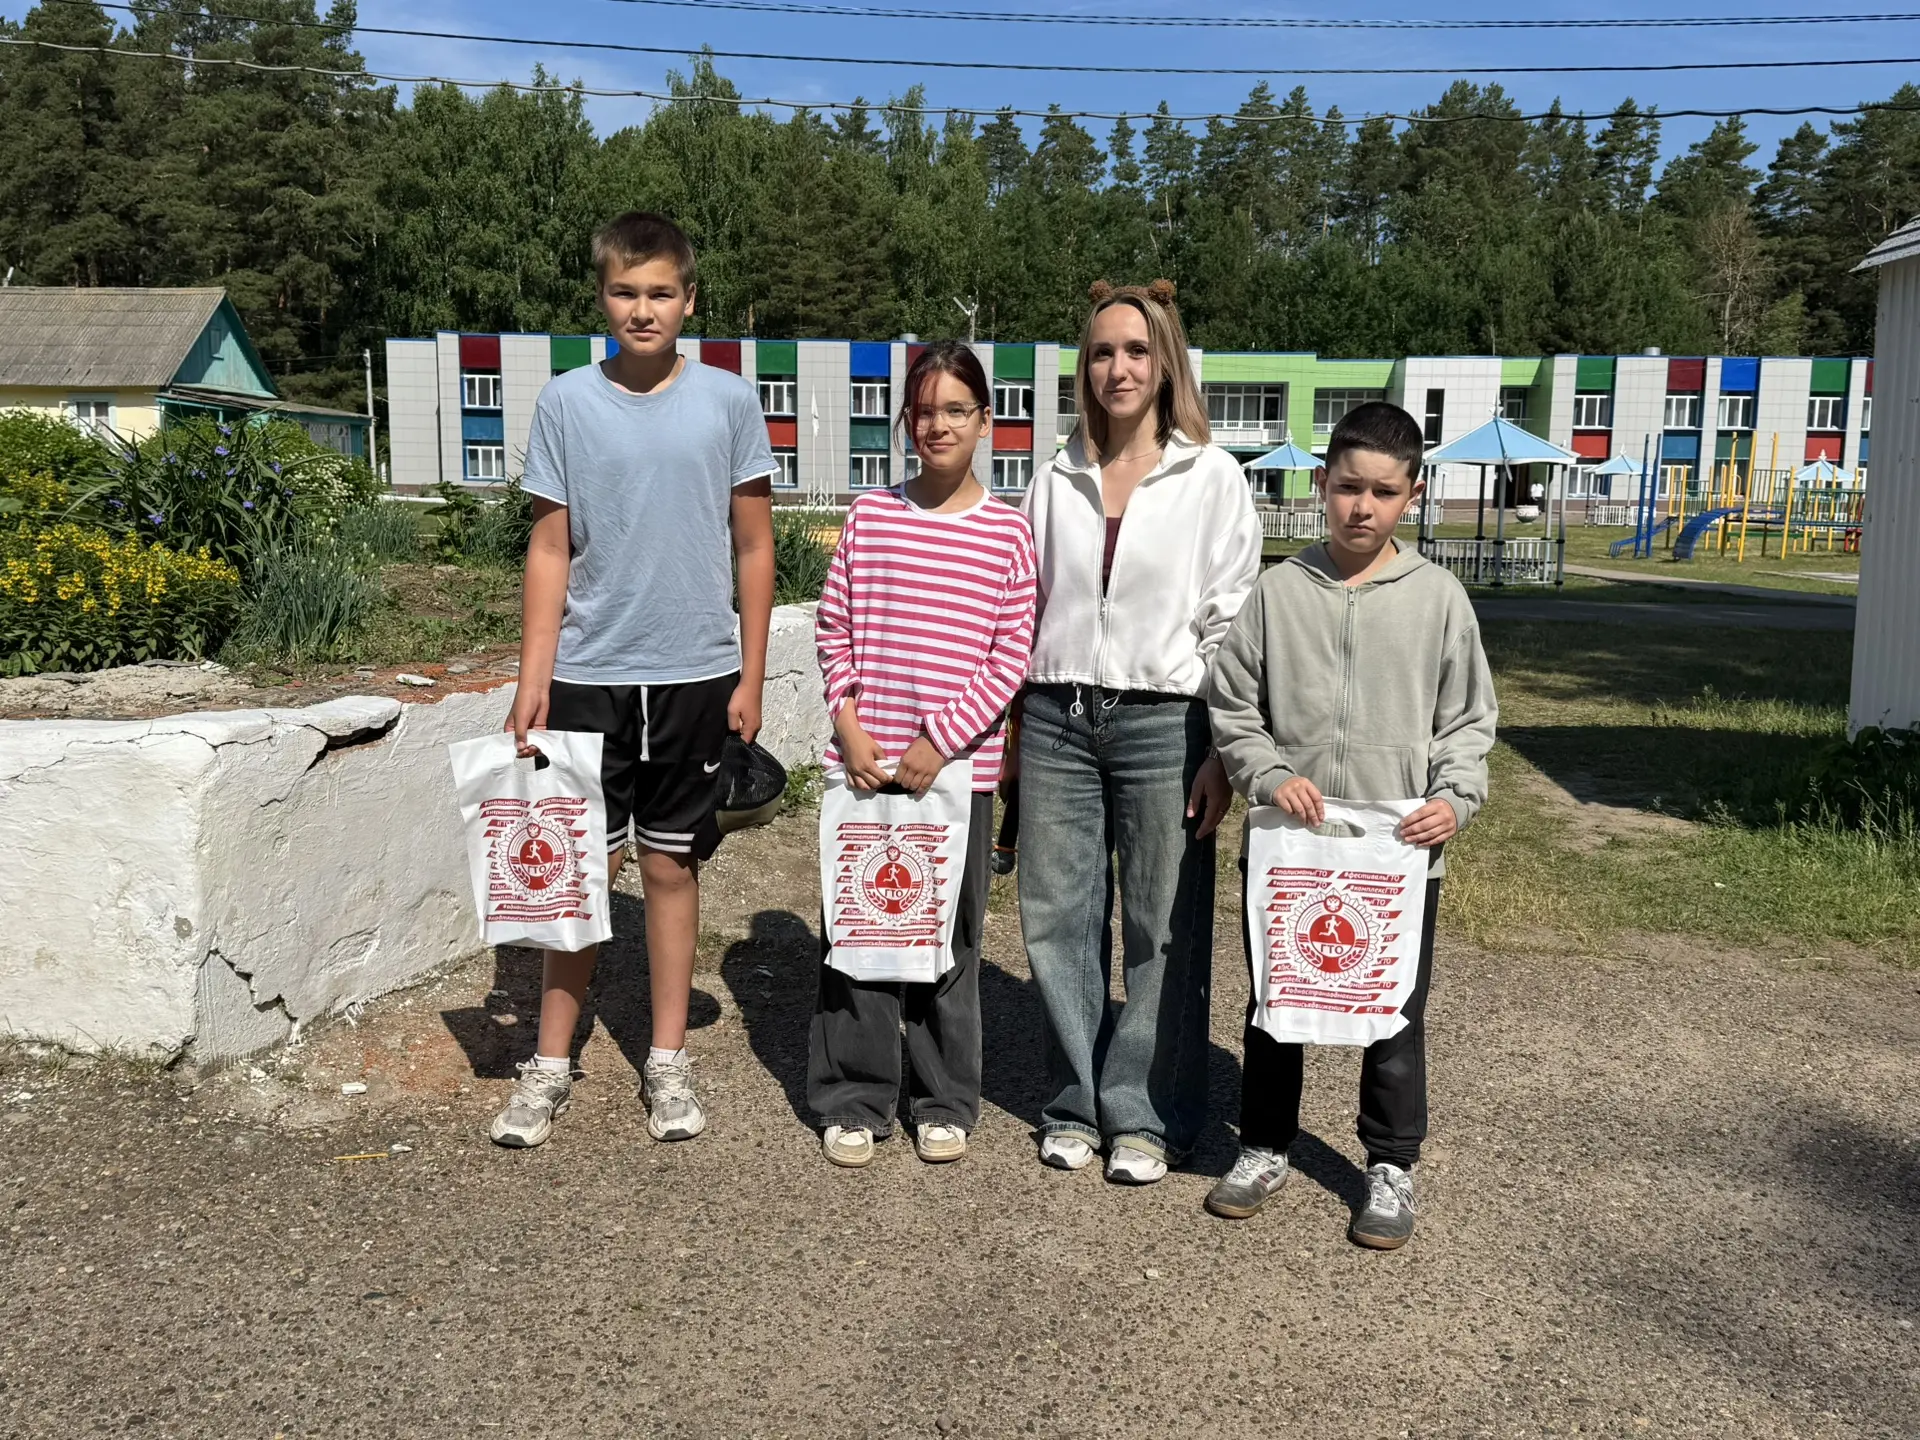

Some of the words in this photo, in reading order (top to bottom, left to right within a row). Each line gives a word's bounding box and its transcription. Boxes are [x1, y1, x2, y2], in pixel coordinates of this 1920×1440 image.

[527, 866, 547, 874] ГТО
[884, 889, 904, 898] ГТО
[1320, 944, 1344, 955] ГТО
[1366, 1006, 1384, 1014] #ГТО
